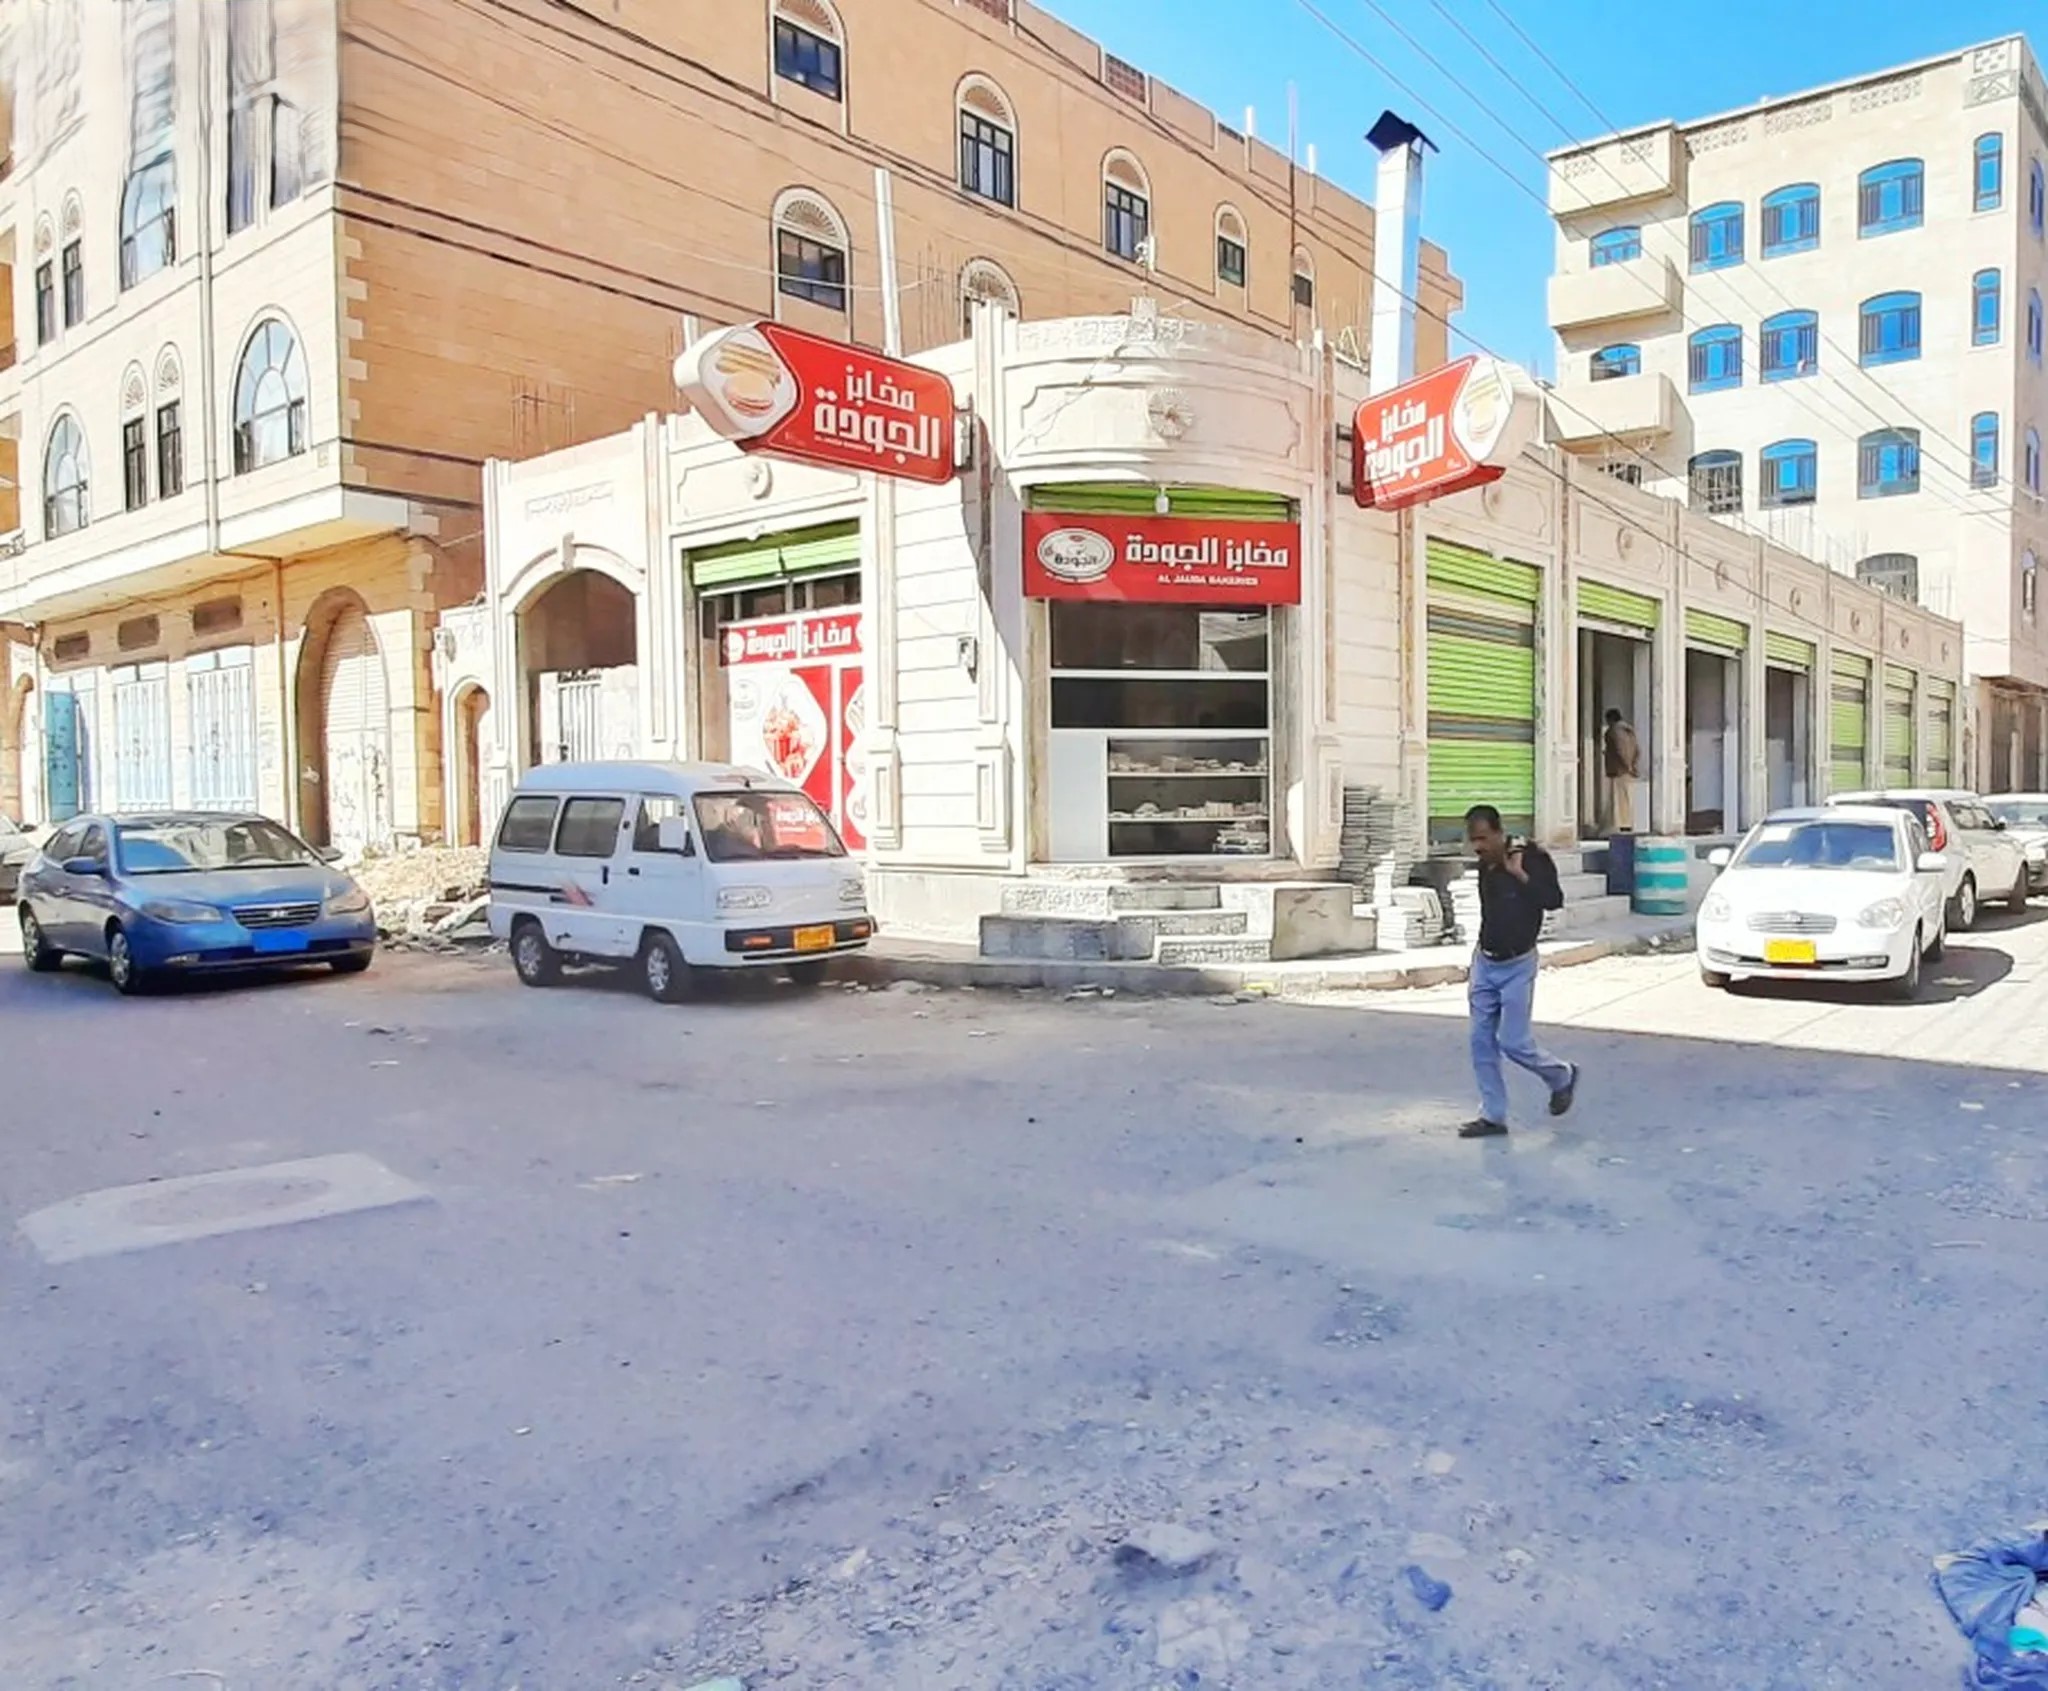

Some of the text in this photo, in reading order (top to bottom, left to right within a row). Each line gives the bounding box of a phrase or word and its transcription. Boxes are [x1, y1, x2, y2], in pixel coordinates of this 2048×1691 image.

[845, 364, 915, 412] مخابز
[814, 387, 940, 464] الجودة
[1381, 399, 1427, 443] مخابز
[1363, 414, 1445, 479] الجودة
[1125, 534, 1289, 572] مخابز الجودة
[803, 621, 852, 655] مخابز
